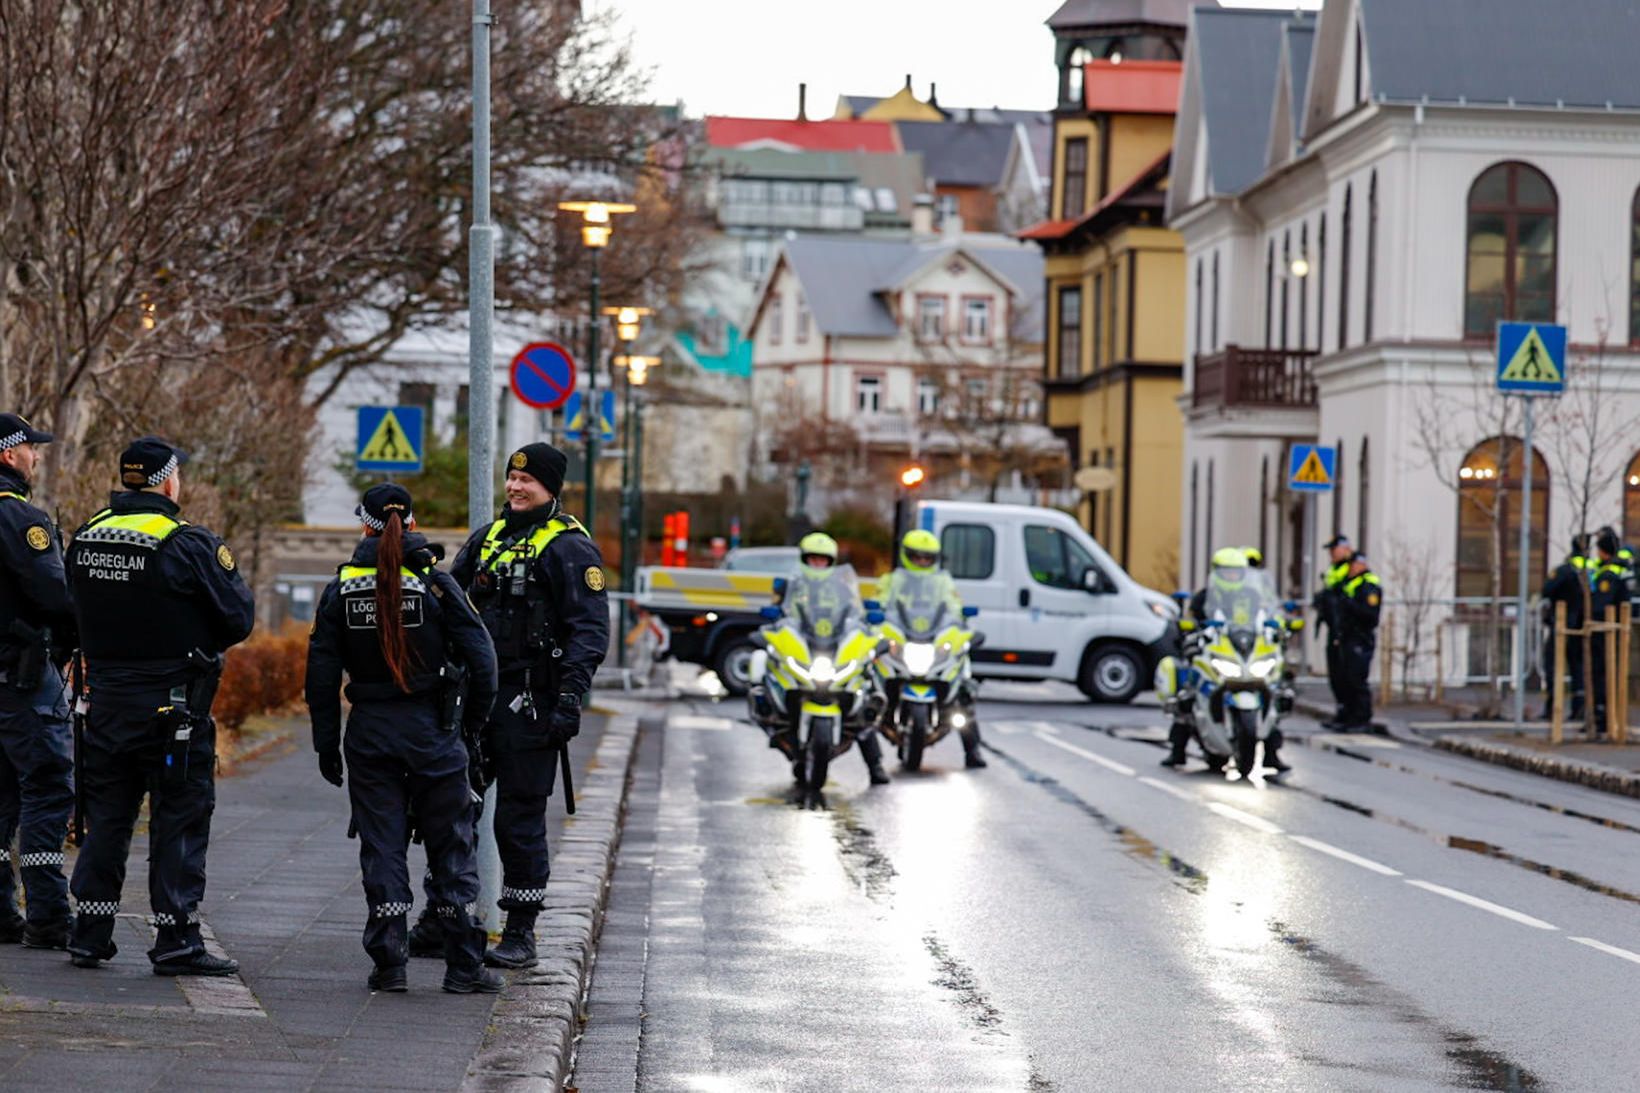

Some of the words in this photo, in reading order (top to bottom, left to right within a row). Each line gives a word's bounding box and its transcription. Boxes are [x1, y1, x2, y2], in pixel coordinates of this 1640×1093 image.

[76, 549, 145, 570] LÖGREGLAN
[89, 568, 130, 581] POLICE
[352, 600, 415, 613] LÖGAN
